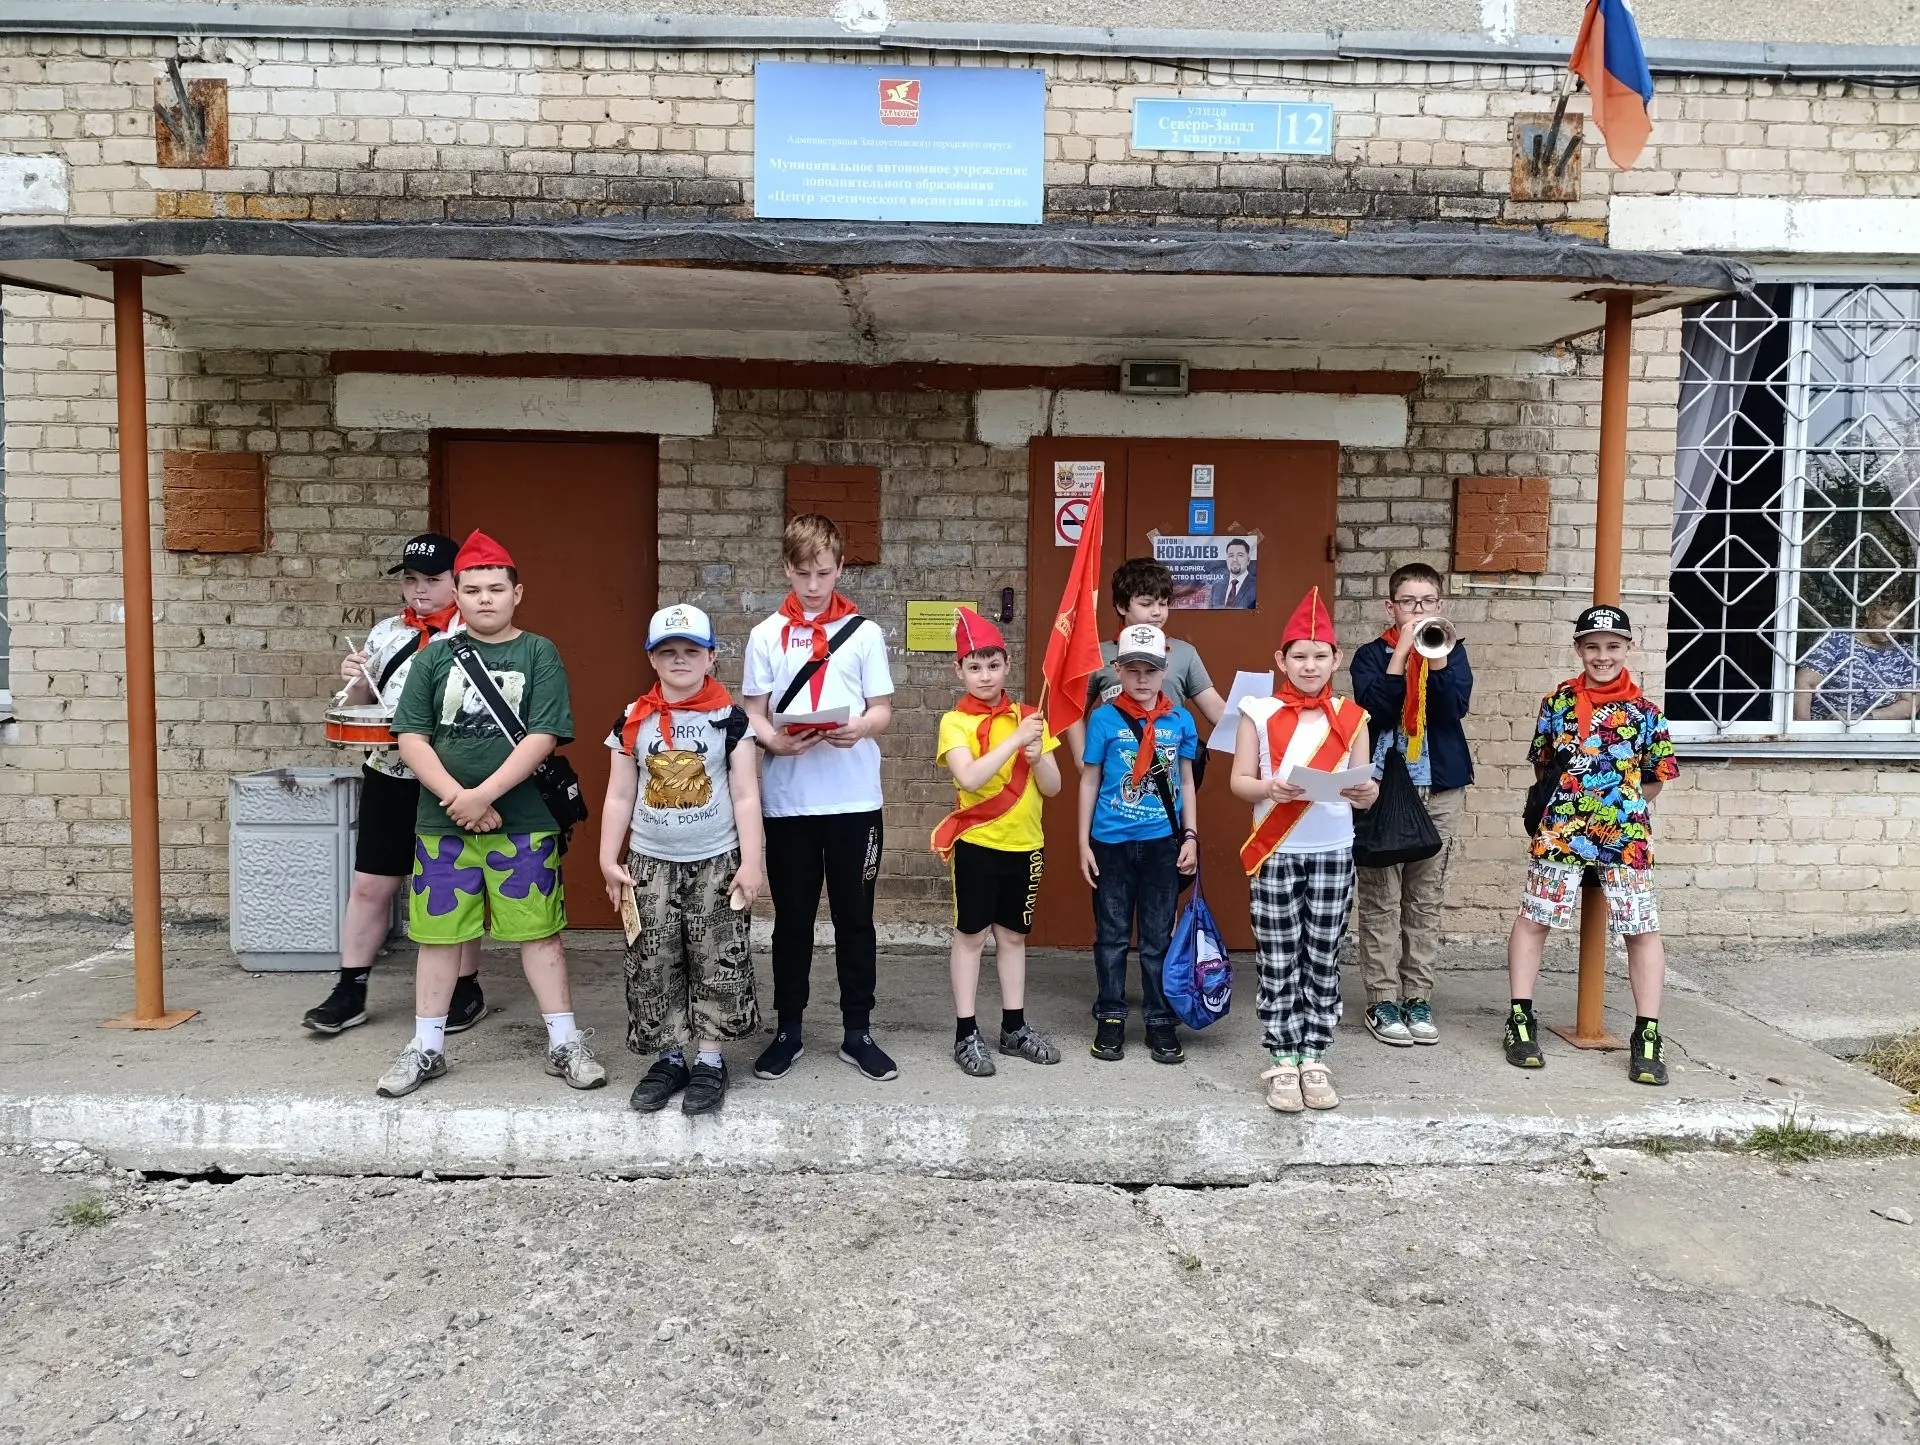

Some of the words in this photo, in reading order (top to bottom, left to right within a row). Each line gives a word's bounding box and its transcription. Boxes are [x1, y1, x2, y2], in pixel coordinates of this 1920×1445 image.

[1187, 105, 1227, 118] улица
[1158, 116, 1255, 132] Северо-Запад
[1285, 111, 1324, 145] 12
[787, 135, 858, 147] Администрация
[861, 137, 931, 149] Златоустовского
[933, 139, 981, 150] городского
[983, 140, 1013, 151] округа
[1171, 131, 1179, 143] 2
[1183, 132, 1241, 146] квартал
[769, 158, 873, 174] Муниципальное
[876, 162, 950, 176] автономное
[953, 165, 1029, 178] учреждение
[802, 177, 912, 190] дополнительного
[915, 177, 994, 192] образования
[819, 192, 907, 206] эстетического
[910, 195, 984, 207] воспитания
[405, 542, 436, 553] BOSS
[1156, 545, 1219, 559] КОВАЛЕВ
[1587, 609, 1621, 621] ATHLETIC
[1593, 616, 1613, 629] 39
